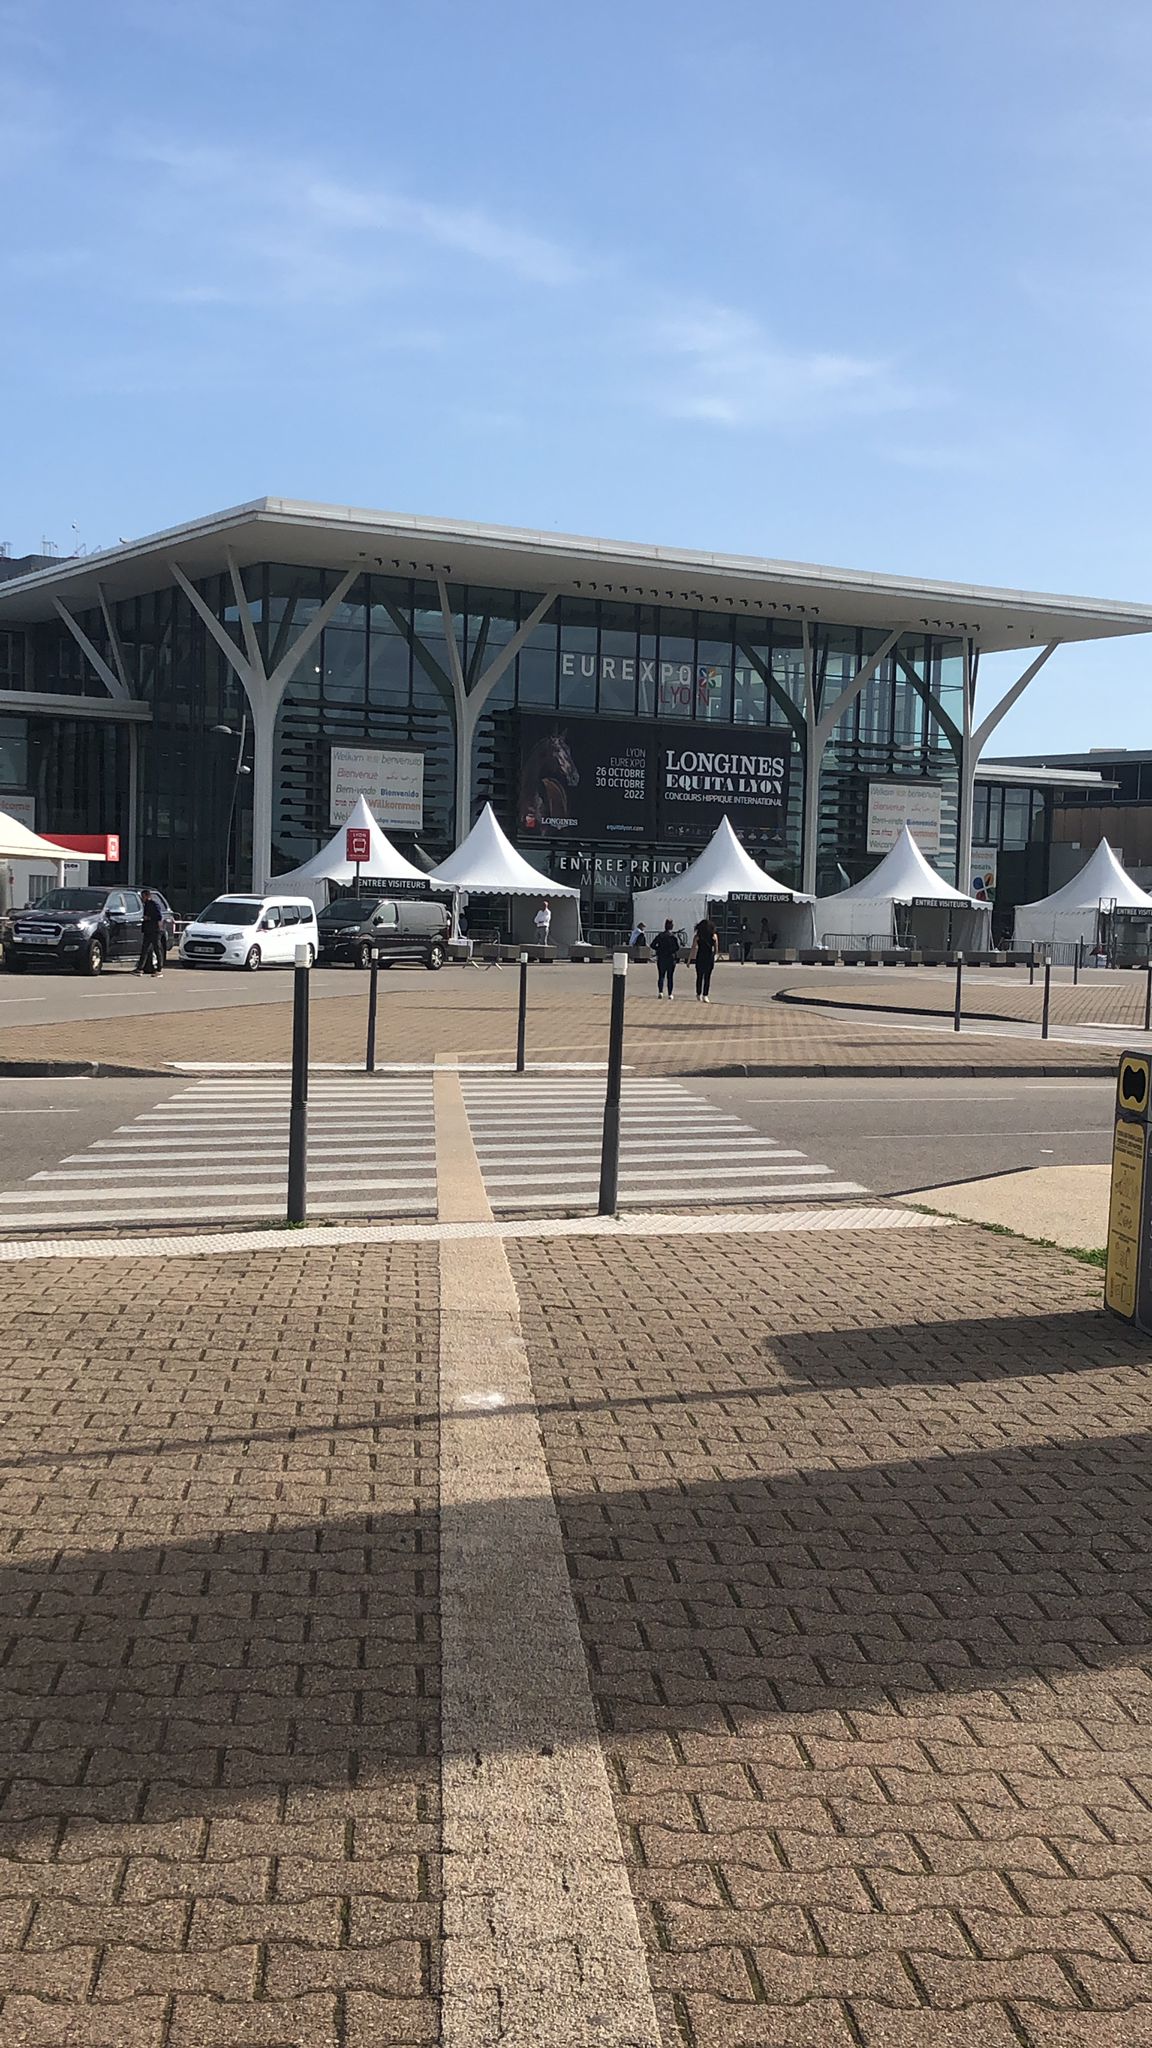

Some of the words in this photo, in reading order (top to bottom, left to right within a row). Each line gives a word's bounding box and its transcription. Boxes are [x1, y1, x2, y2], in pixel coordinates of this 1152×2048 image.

[562, 654, 692, 685] EUREXPO
[660, 685, 710, 705] LYON
[626, 747, 646, 758] LYON
[610, 757, 646, 768] EUREXPO
[665, 750, 785, 778] LONGINES
[595, 766, 607, 776] 26
[608, 767, 645, 779] OCTOBRE
[595, 777, 607, 787] 30
[608, 778, 645, 789] OCTOBRE
[666, 773, 734, 792] EQUITA
[738, 778, 783, 794] LYON
[624, 789, 645, 800] 2022
[664, 791, 702, 802] CONCOURS
[702, 794, 733, 804] HIPPIQUE
[733, 796, 783, 807] INTERNATIONAL
[541, 817, 578, 826] LONGINES
[559, 857, 624, 872] ENTREE
[387, 880, 426, 889] VISITEURS
[580, 873, 618, 887] MAIN
[757, 893, 790, 902] VISITEURS
